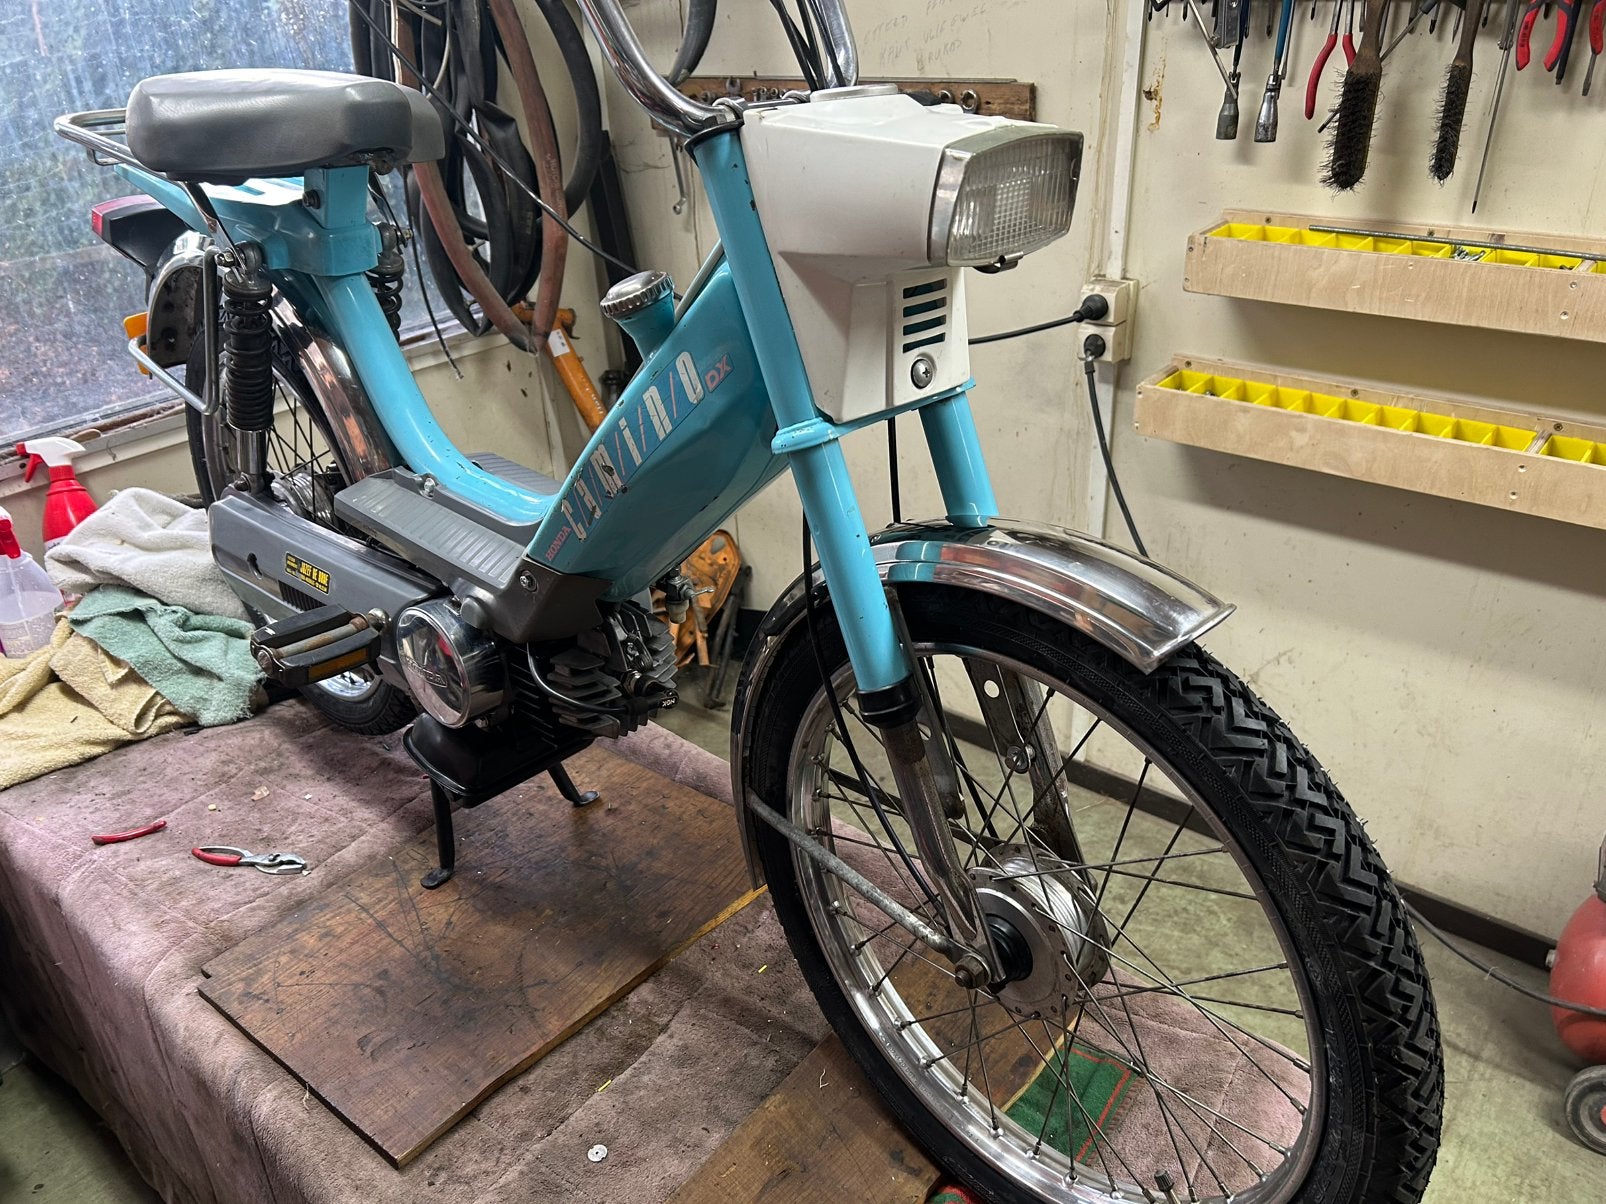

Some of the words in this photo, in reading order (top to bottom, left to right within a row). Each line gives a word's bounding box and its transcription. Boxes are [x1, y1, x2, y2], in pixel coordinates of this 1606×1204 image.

[705, 354, 732, 389] DX
[545, 526, 572, 561] HONDA
[661, 697, 675, 707] NGK
